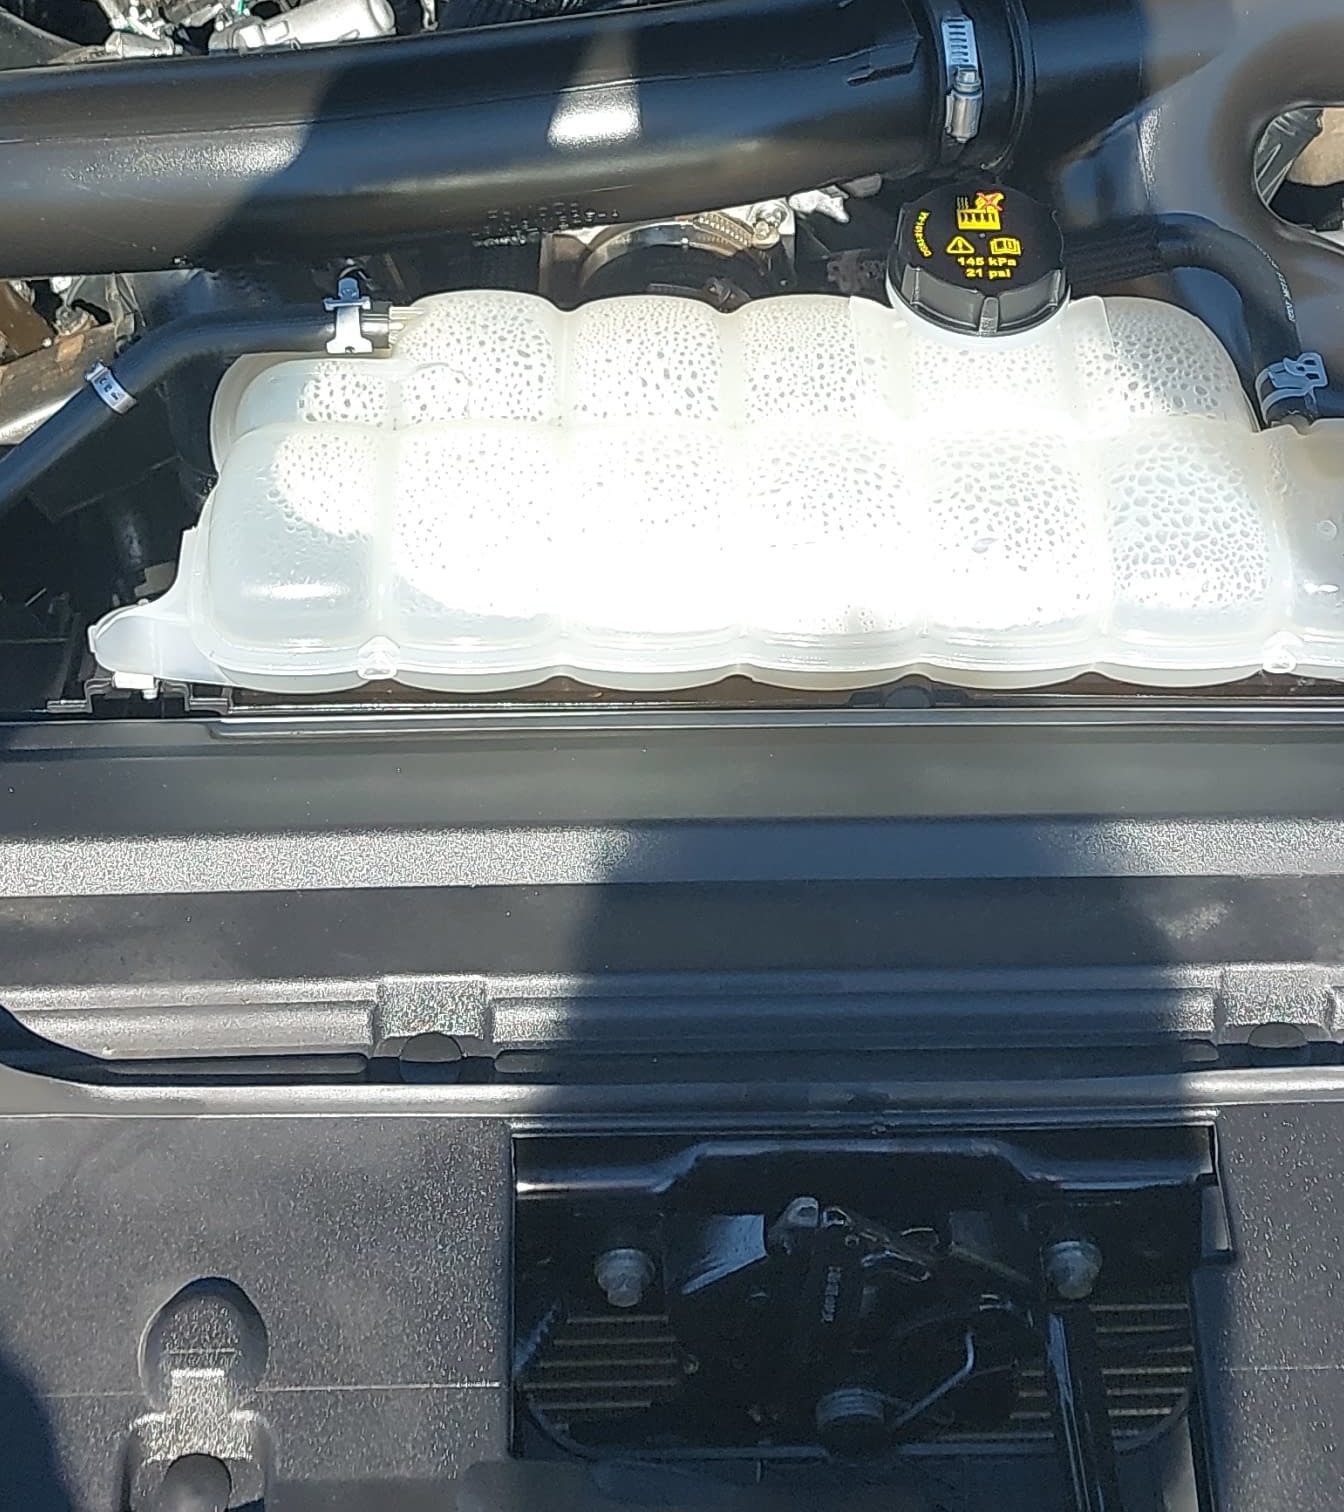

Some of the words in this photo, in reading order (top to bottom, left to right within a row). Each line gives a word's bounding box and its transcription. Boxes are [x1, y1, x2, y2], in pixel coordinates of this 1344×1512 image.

[957, 256, 985, 266] 145
[988, 256, 1017, 267] kPa
[966, 268, 983, 278] 21
[988, 268, 1011, 280] psi
